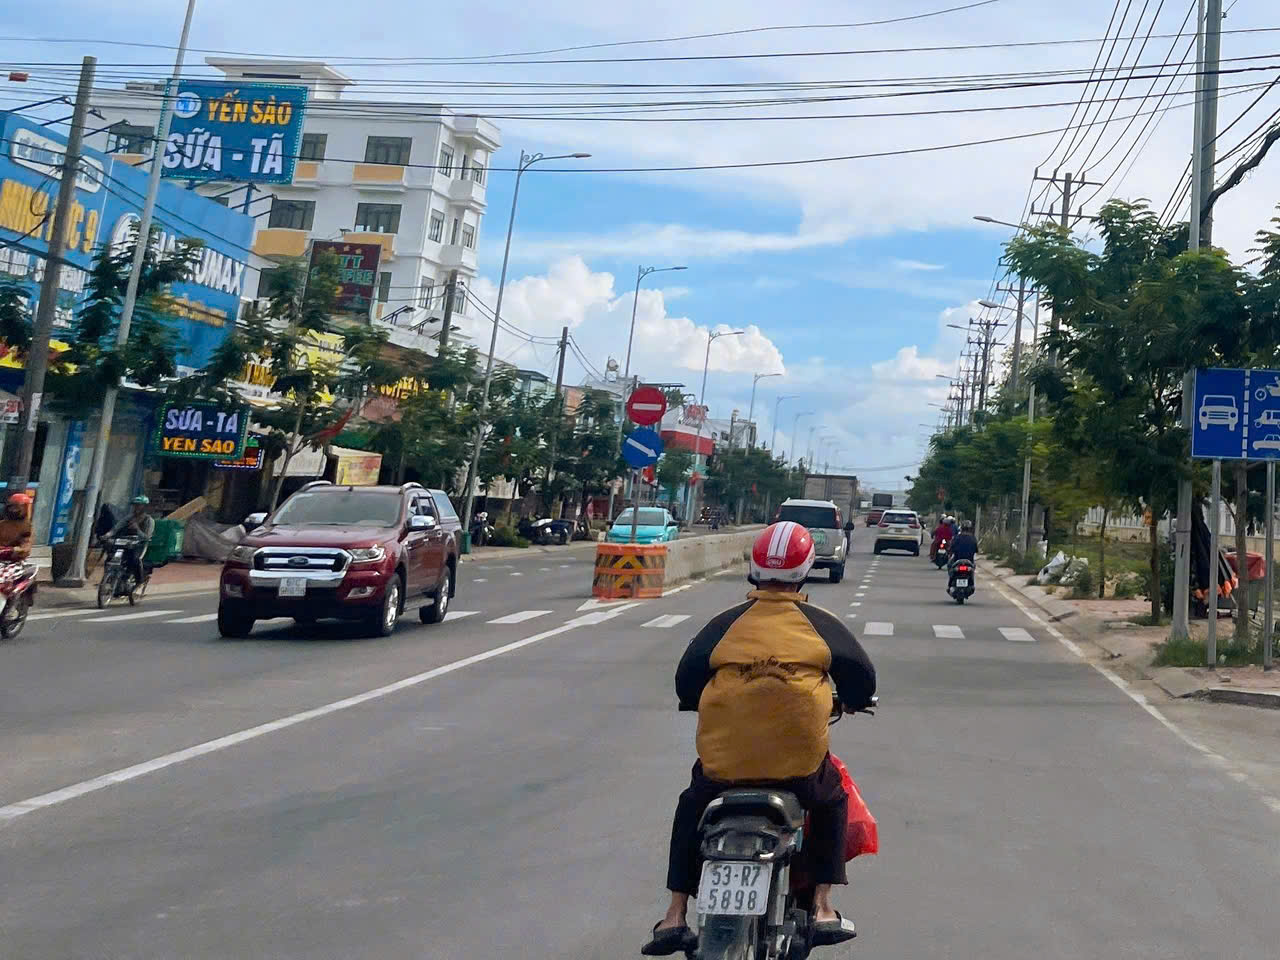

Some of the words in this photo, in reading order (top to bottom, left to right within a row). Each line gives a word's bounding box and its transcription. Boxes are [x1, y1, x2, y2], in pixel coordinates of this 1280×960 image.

[208, 89, 249, 122] YẾN
[250, 95, 292, 125] SÀO
[163, 127, 222, 172] SỮA
[250, 133, 284, 175] TÃ
[711, 864, 761, 887] 53-R7
[707, 888, 757, 911] 5898
